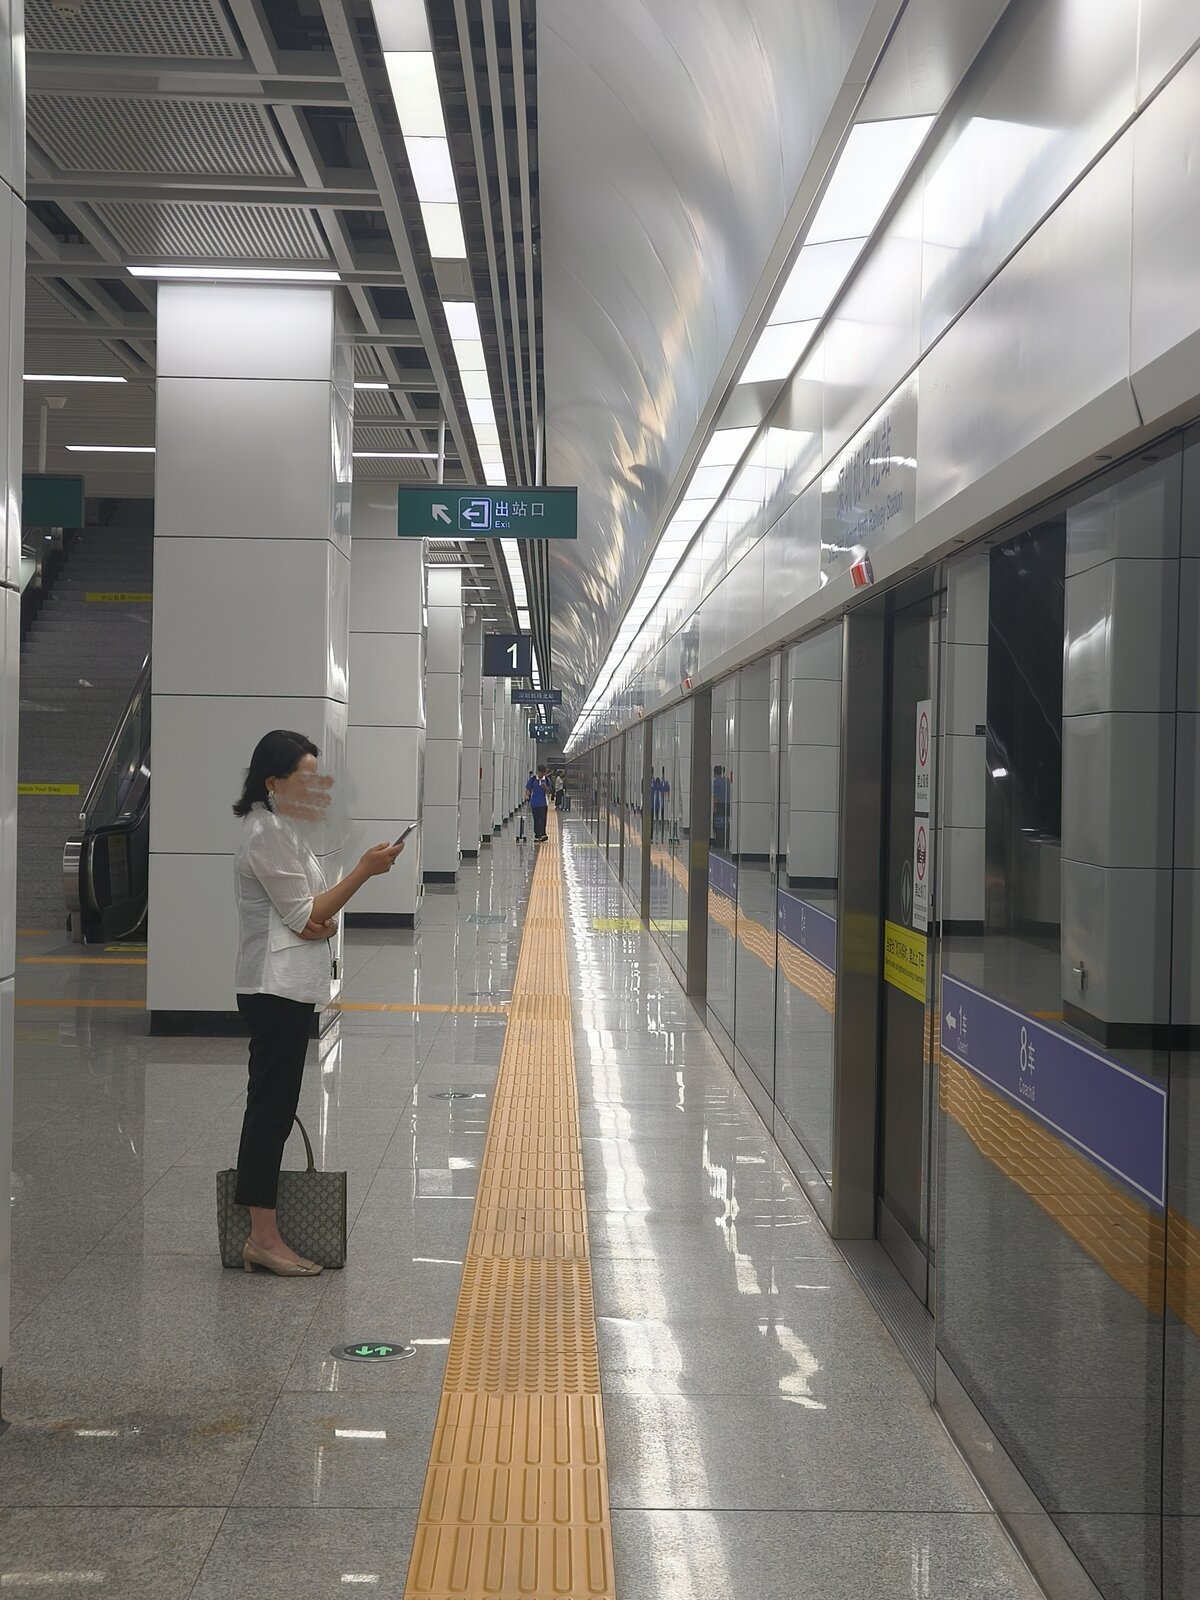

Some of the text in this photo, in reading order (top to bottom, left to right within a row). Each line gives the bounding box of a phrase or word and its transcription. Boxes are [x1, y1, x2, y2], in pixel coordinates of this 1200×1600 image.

[495, 500, 544, 517] 出站口
[495, 520, 511, 528] Exit
[506, 642, 518, 669] 1
[1020, 1026, 1036, 1076] 8车
